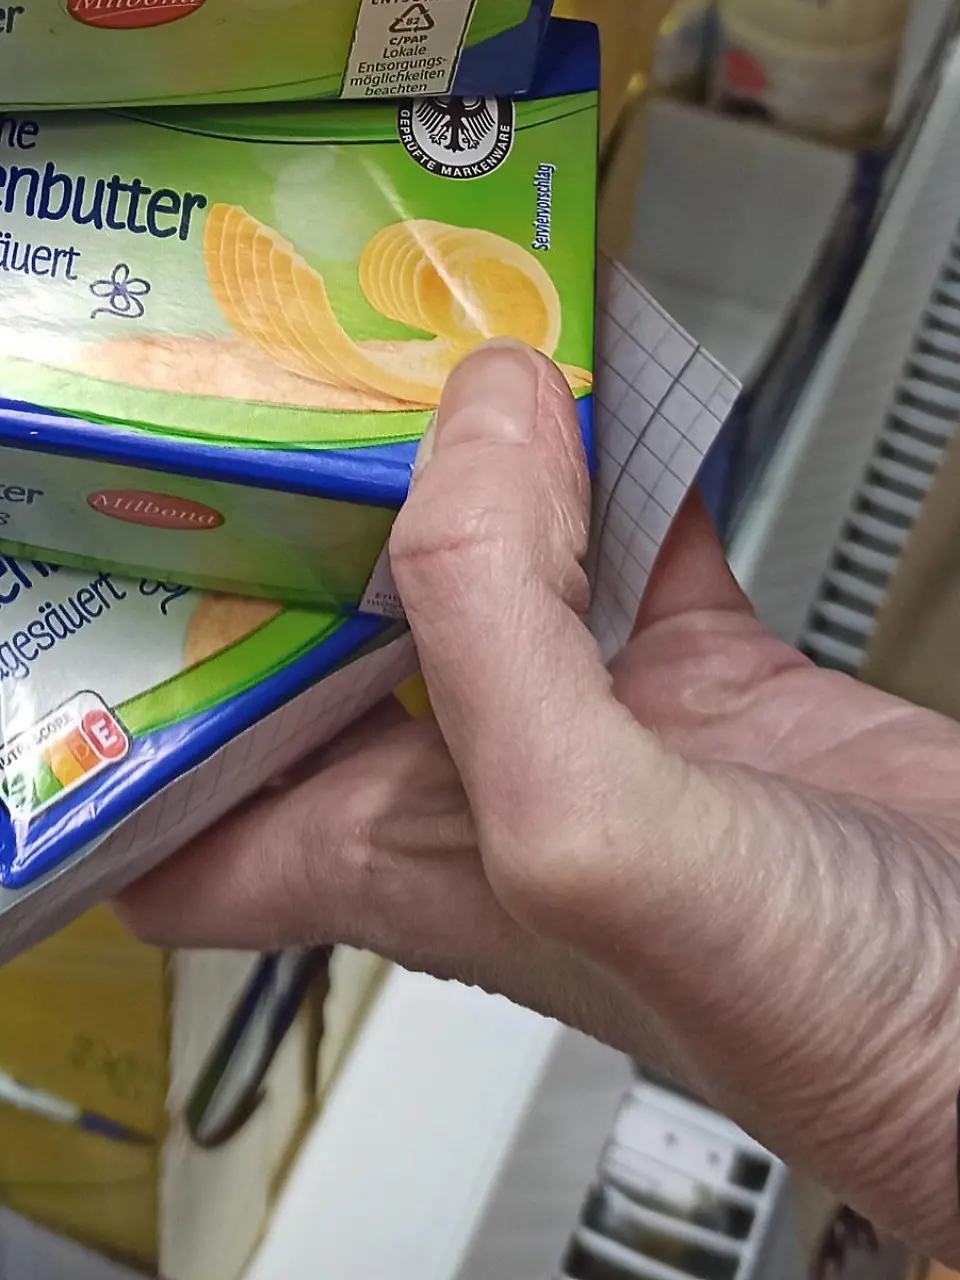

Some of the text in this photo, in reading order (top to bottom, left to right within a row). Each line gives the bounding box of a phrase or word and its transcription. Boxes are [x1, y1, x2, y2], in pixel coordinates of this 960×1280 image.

[390, 35, 428, 46] C/PAP
[383, 45, 427, 59] Lokale
[358, 56, 448, 73] Entsorgungs-
[350, 69, 445, 87] möglichkeiten
[365, 83, 427, 96] beachten
[441, 124, 511, 177] MARKENWARE
[94, 494, 215, 525] Milbona
[92, 717, 117, 748] E
